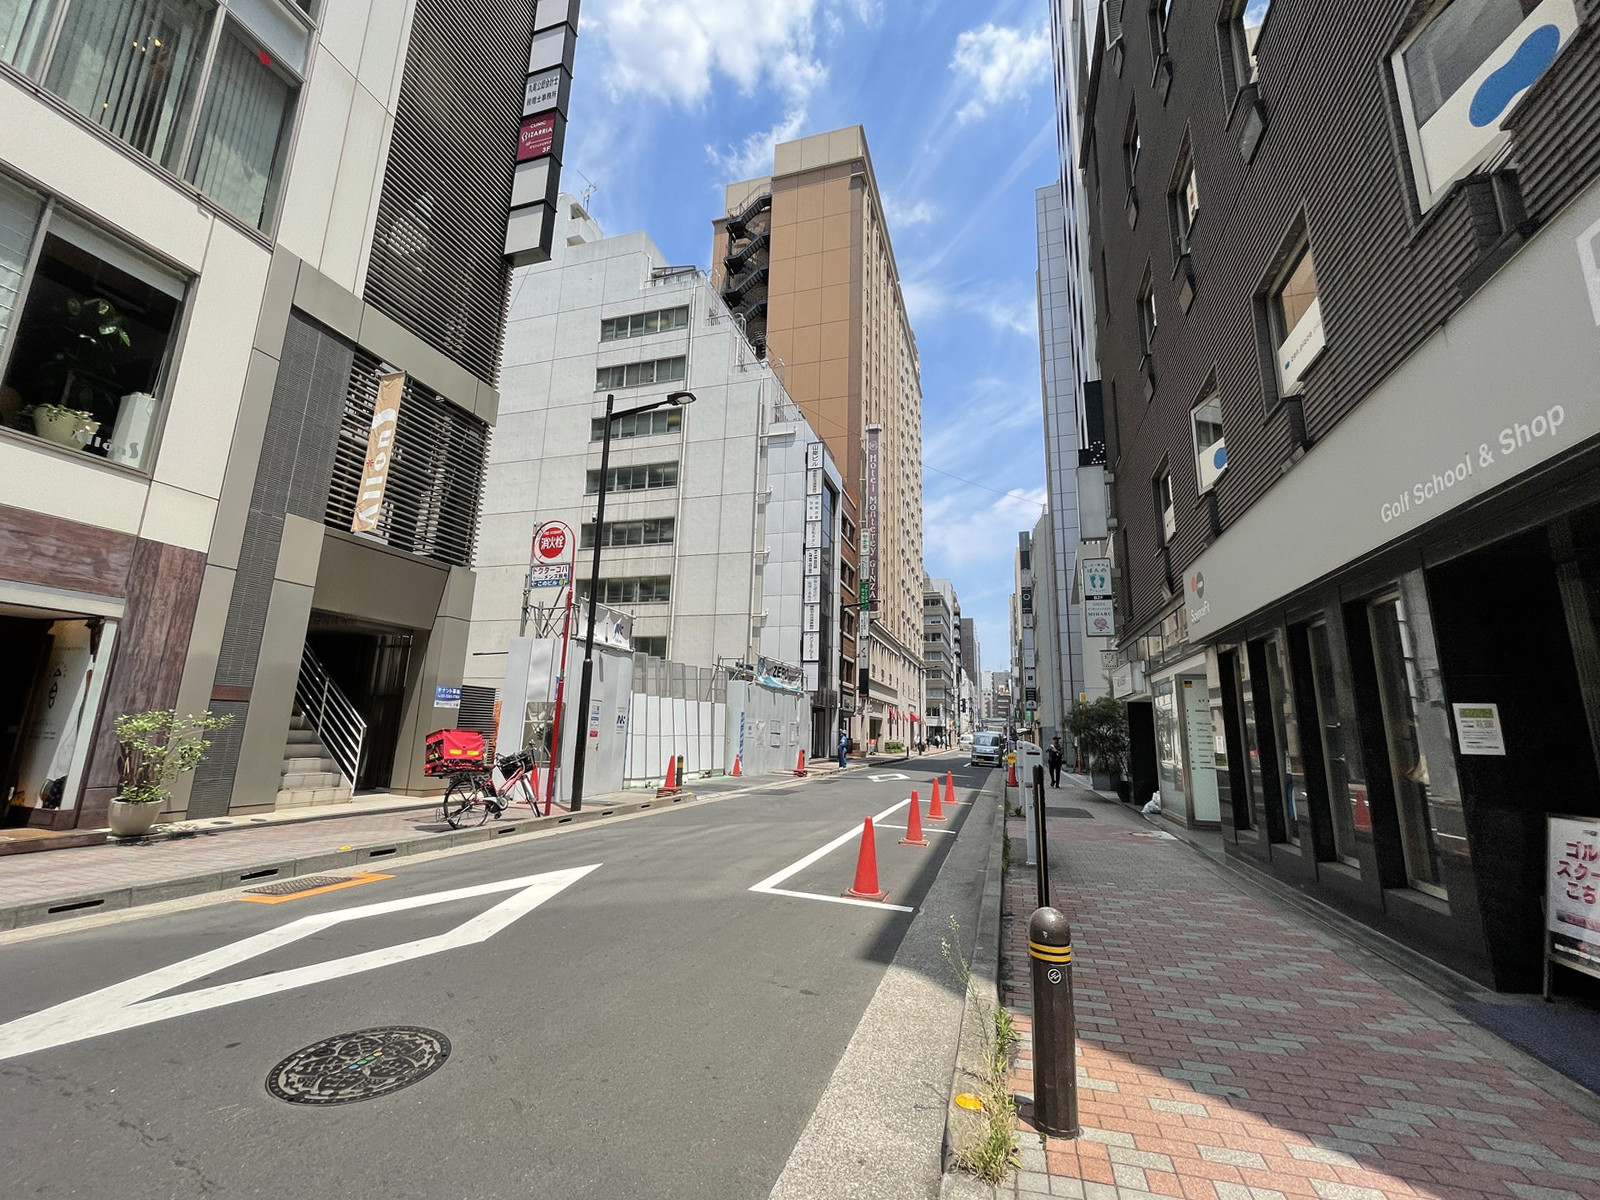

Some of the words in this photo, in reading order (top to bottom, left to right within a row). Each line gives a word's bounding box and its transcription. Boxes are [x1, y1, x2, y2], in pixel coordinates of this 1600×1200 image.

[542, 145, 551, 153] 3F
[869, 454, 877, 492] Hotel
[1380, 491, 1410, 523] Golf
[1413, 454, 1472, 505] School
[1478, 443, 1494, 468] &
[1499, 404, 1565, 455] Shop
[869, 496, 877, 556] Monterey
[541, 535, 564, 550] 消火栓
[537, 579, 558, 587] このビル
[869, 560, 877, 598] GINZA
[1566, 840, 1598, 862] ゴル
[1566, 881, 1596, 905] こち
